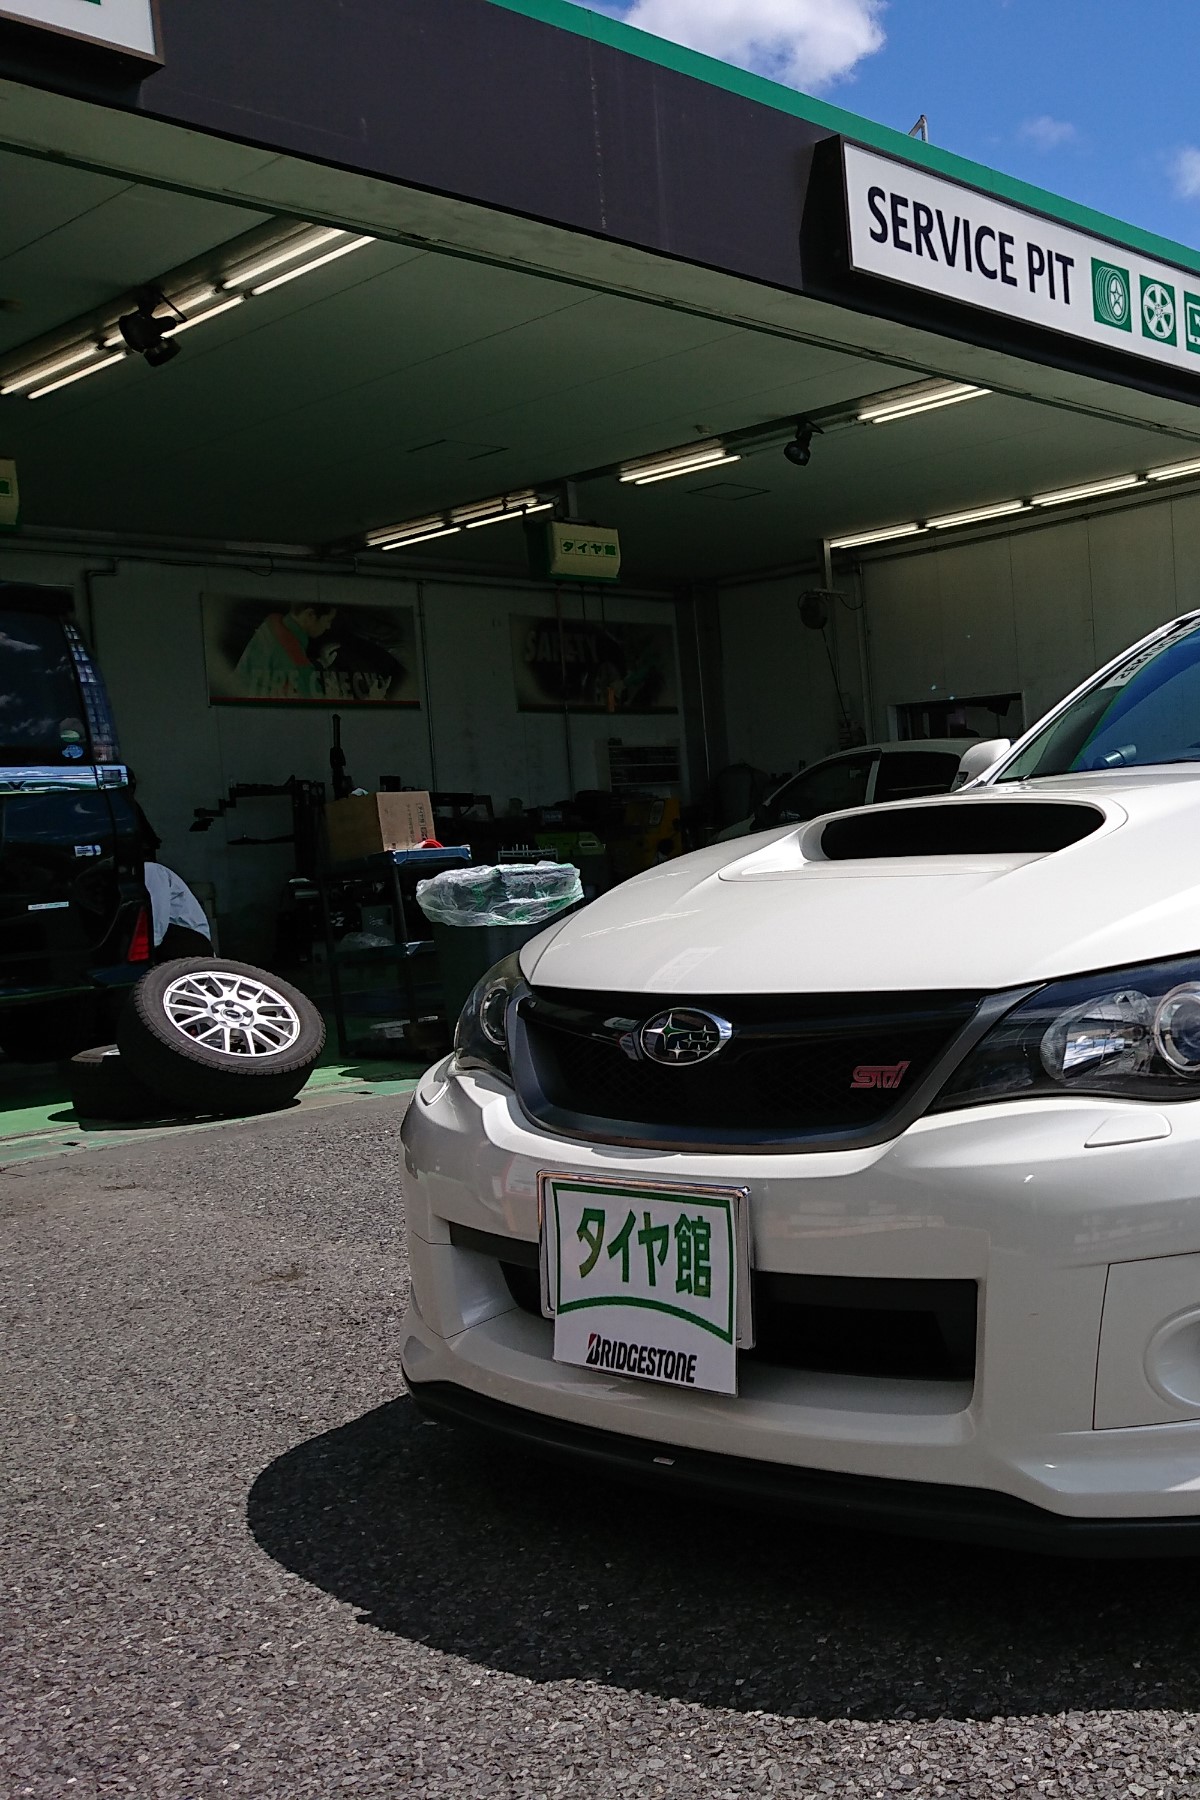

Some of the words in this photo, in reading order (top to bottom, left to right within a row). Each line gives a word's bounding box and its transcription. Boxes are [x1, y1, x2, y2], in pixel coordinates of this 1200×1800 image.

[868, 186, 1017, 287] SERVICE
[1027, 241, 1075, 305] PIT
[577, 1207, 711, 1298] タイヤ館
[586, 1331, 698, 1384] BRIDGESTONE
